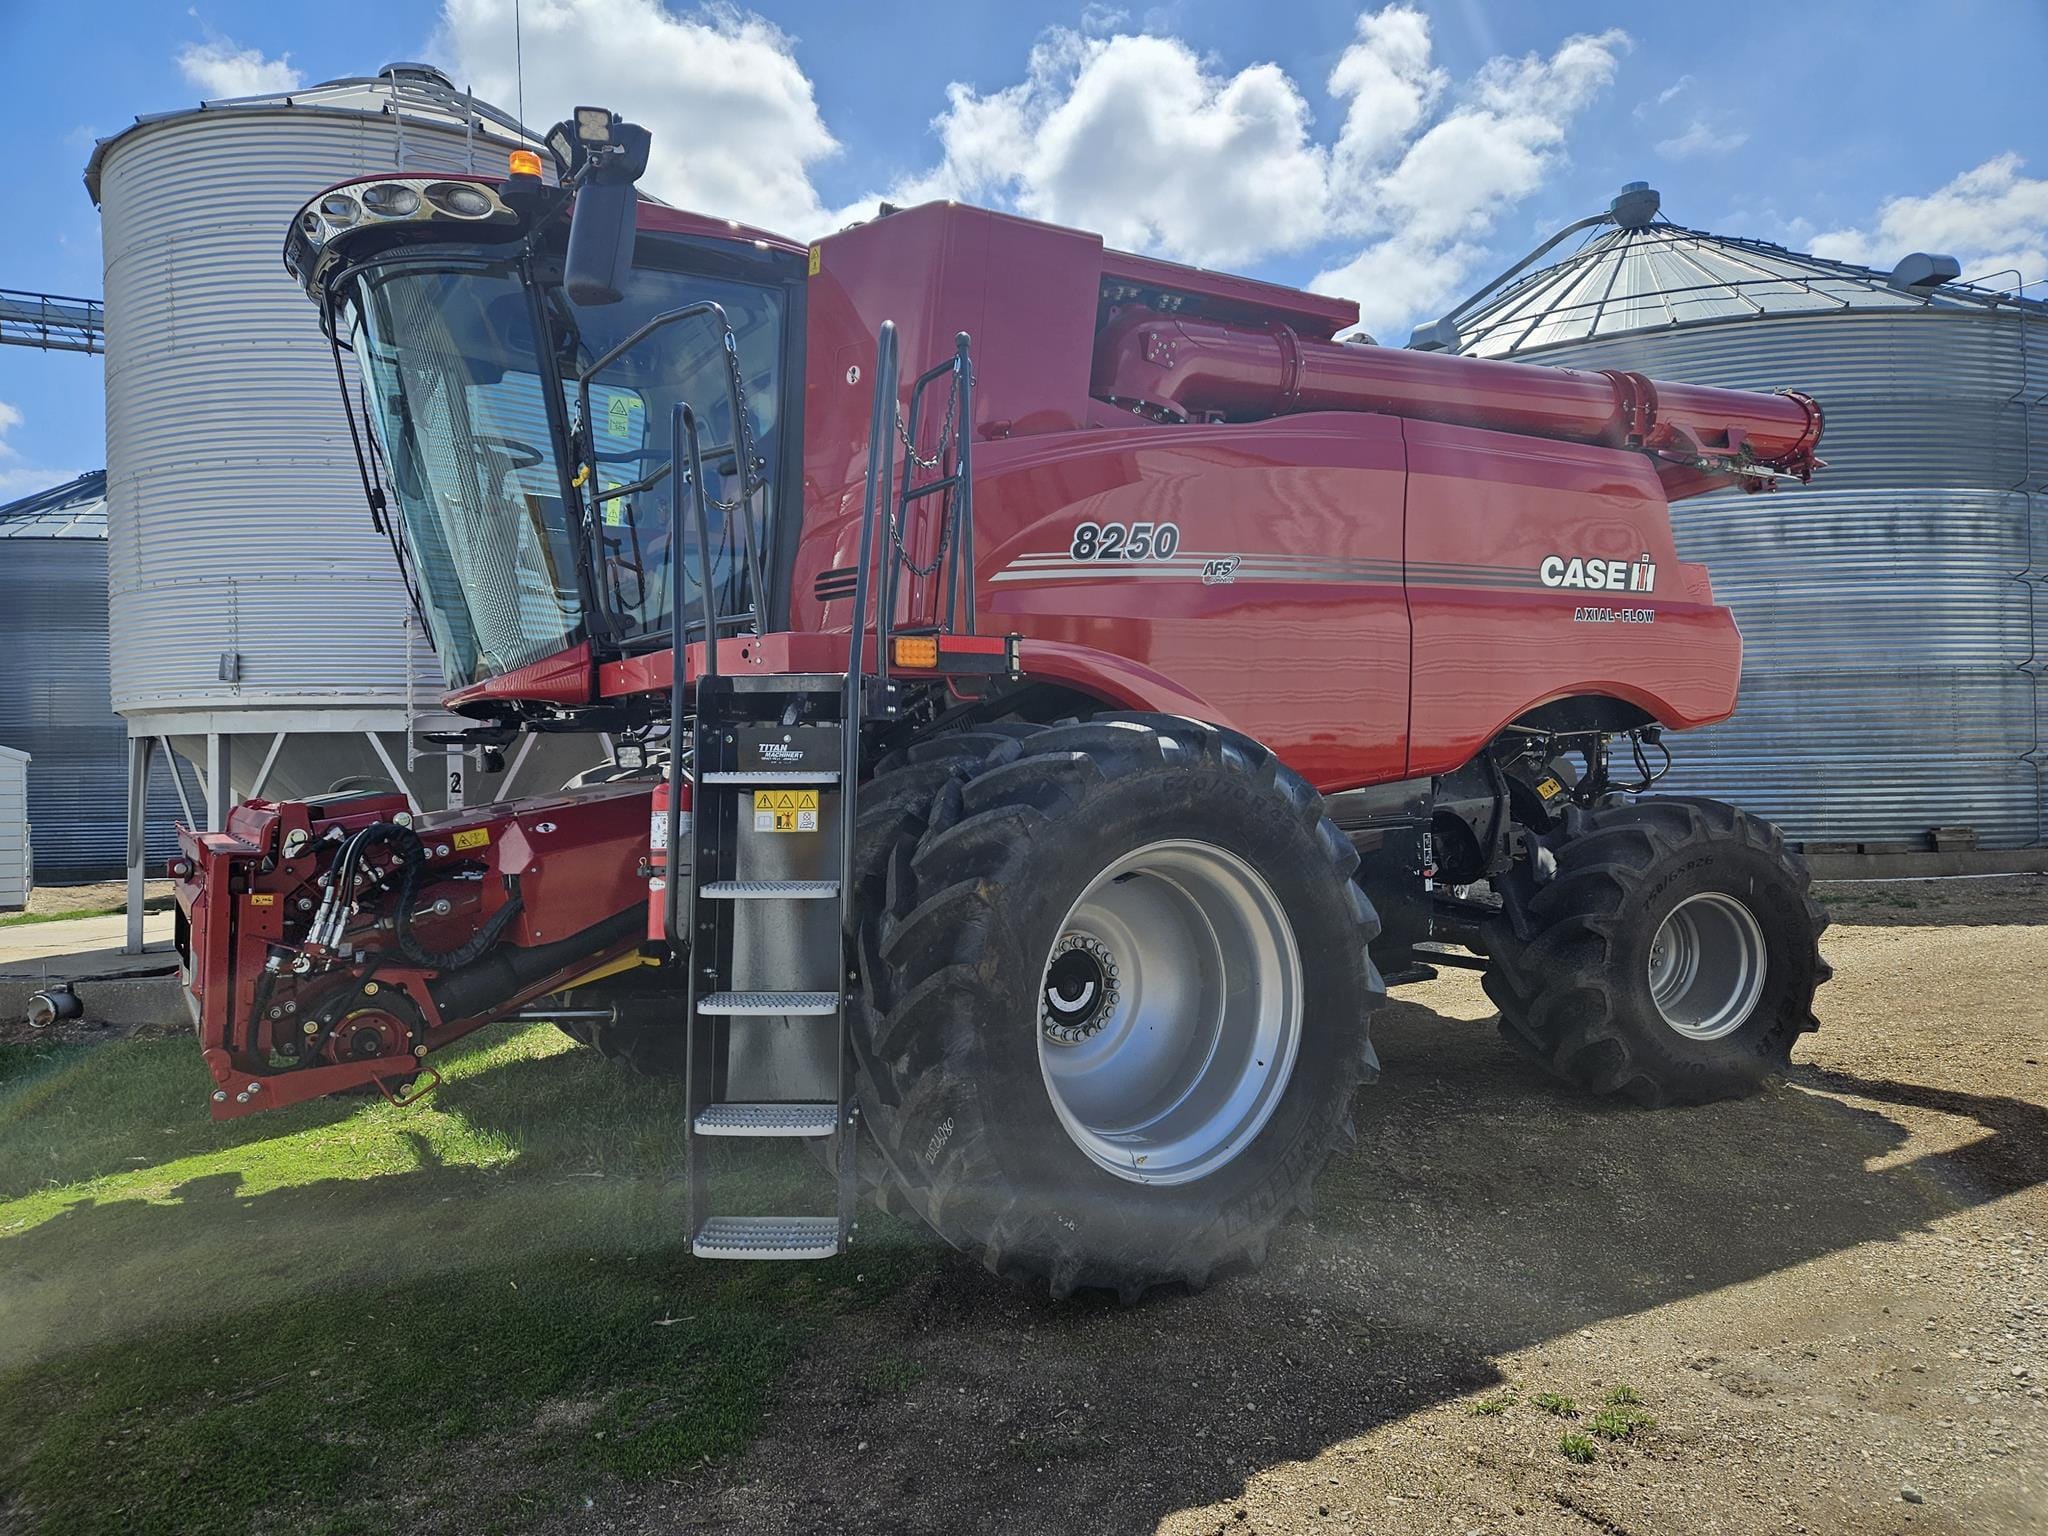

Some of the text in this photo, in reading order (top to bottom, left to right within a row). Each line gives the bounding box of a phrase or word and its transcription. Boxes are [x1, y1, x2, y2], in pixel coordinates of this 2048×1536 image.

[1070, 522, 1180, 562] 8250
[1202, 560, 1233, 576] AFS
[1540, 554, 1628, 590] CASE
[1574, 607, 1655, 623] AXIAL-FLOW
[758, 743, 788, 751] TITAN
[449, 771, 462, 794] 2
